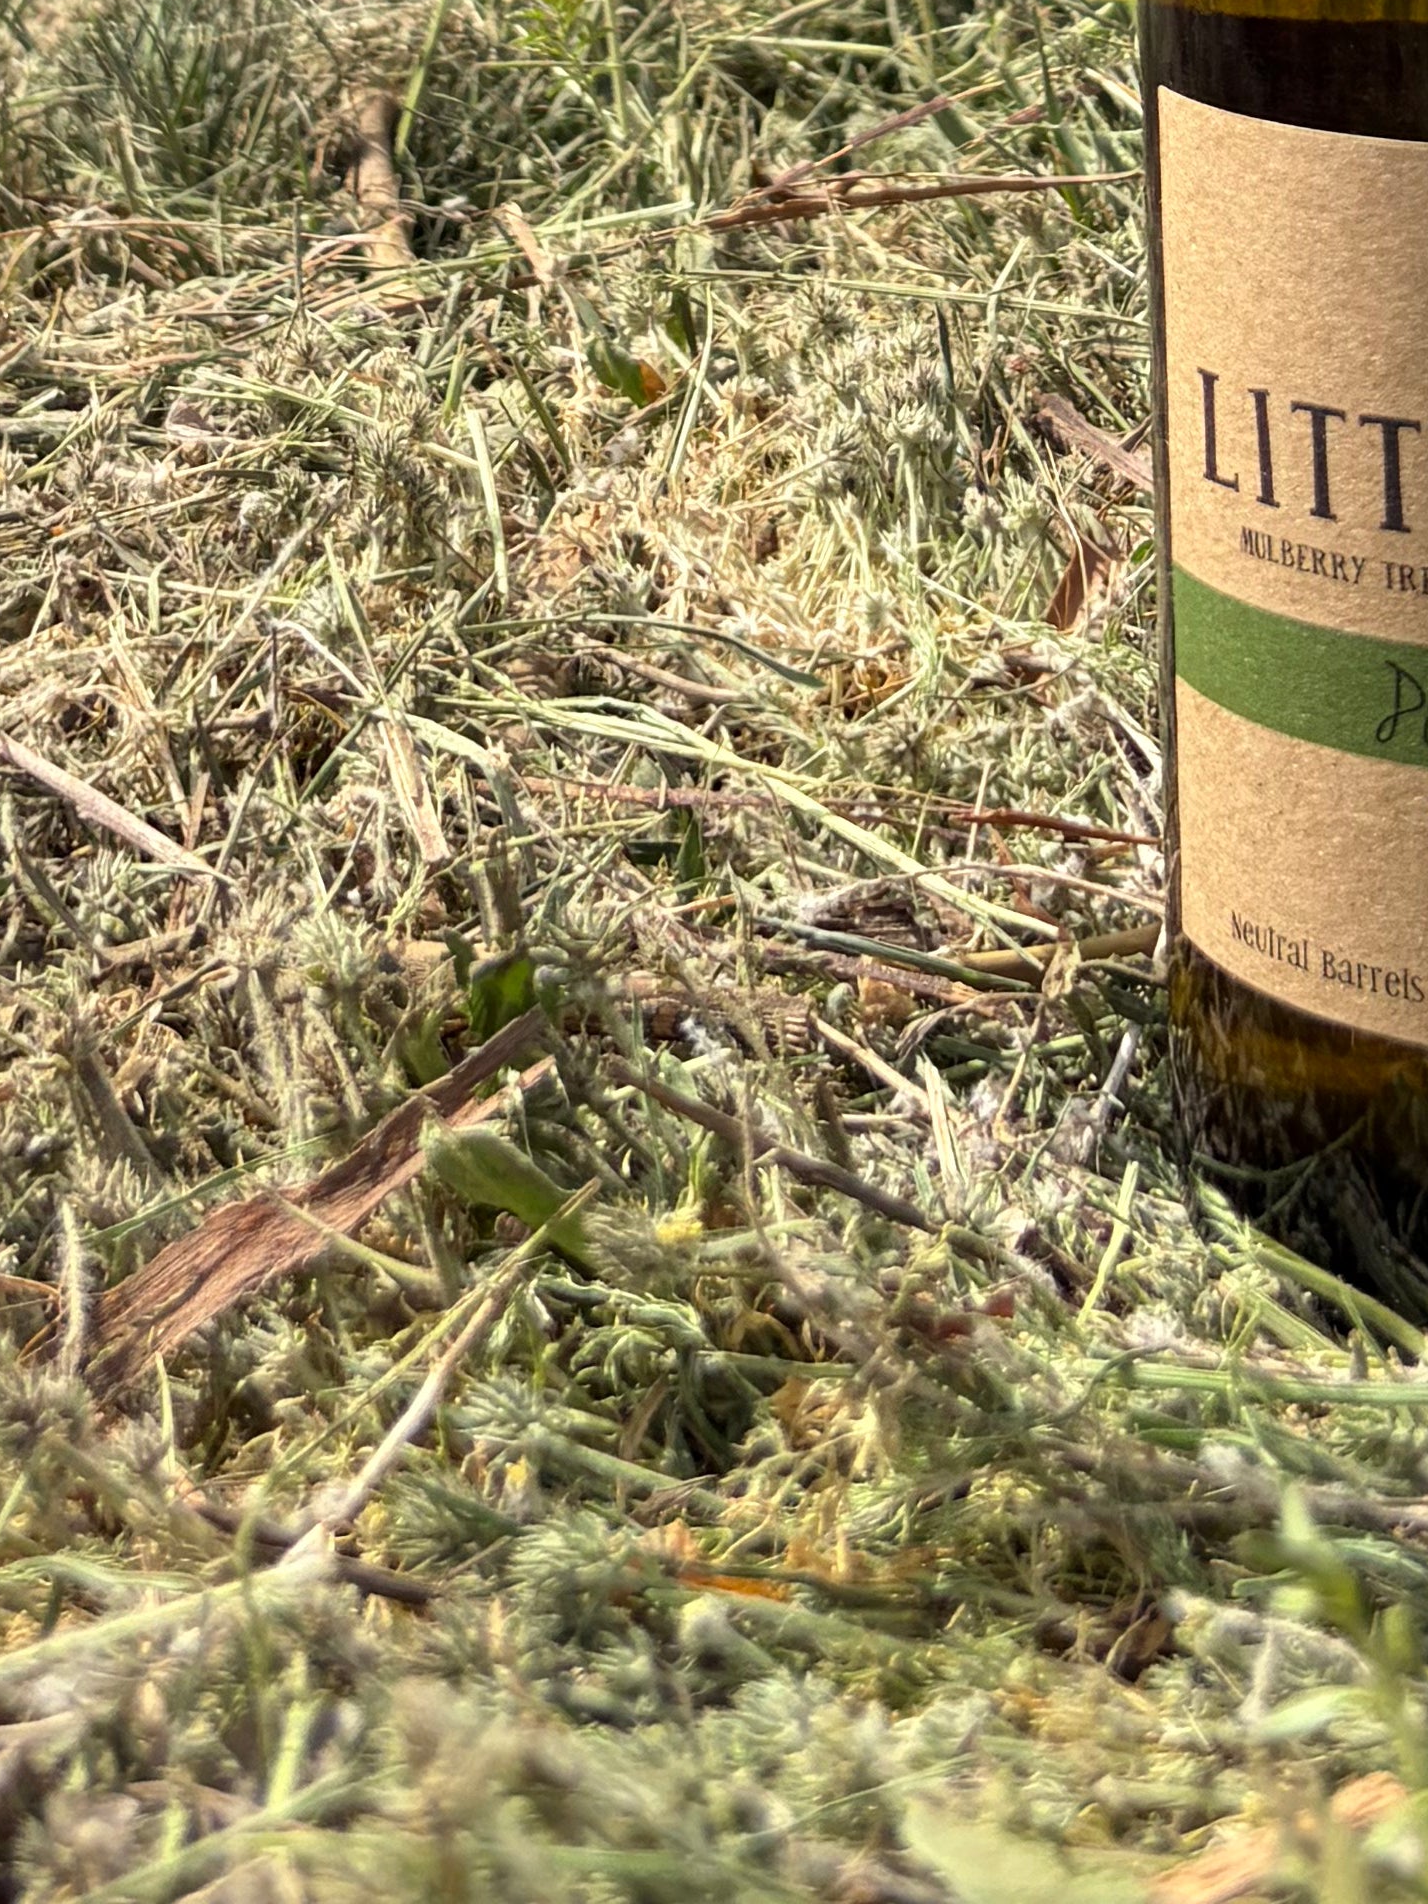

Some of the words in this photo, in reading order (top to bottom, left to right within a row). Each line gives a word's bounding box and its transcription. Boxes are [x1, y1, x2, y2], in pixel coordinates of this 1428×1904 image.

[1240, 525, 1367, 585] MULBERRY
[1230, 909, 1310, 972] Neutral
[1321, 948, 1426, 1004] Barrels
